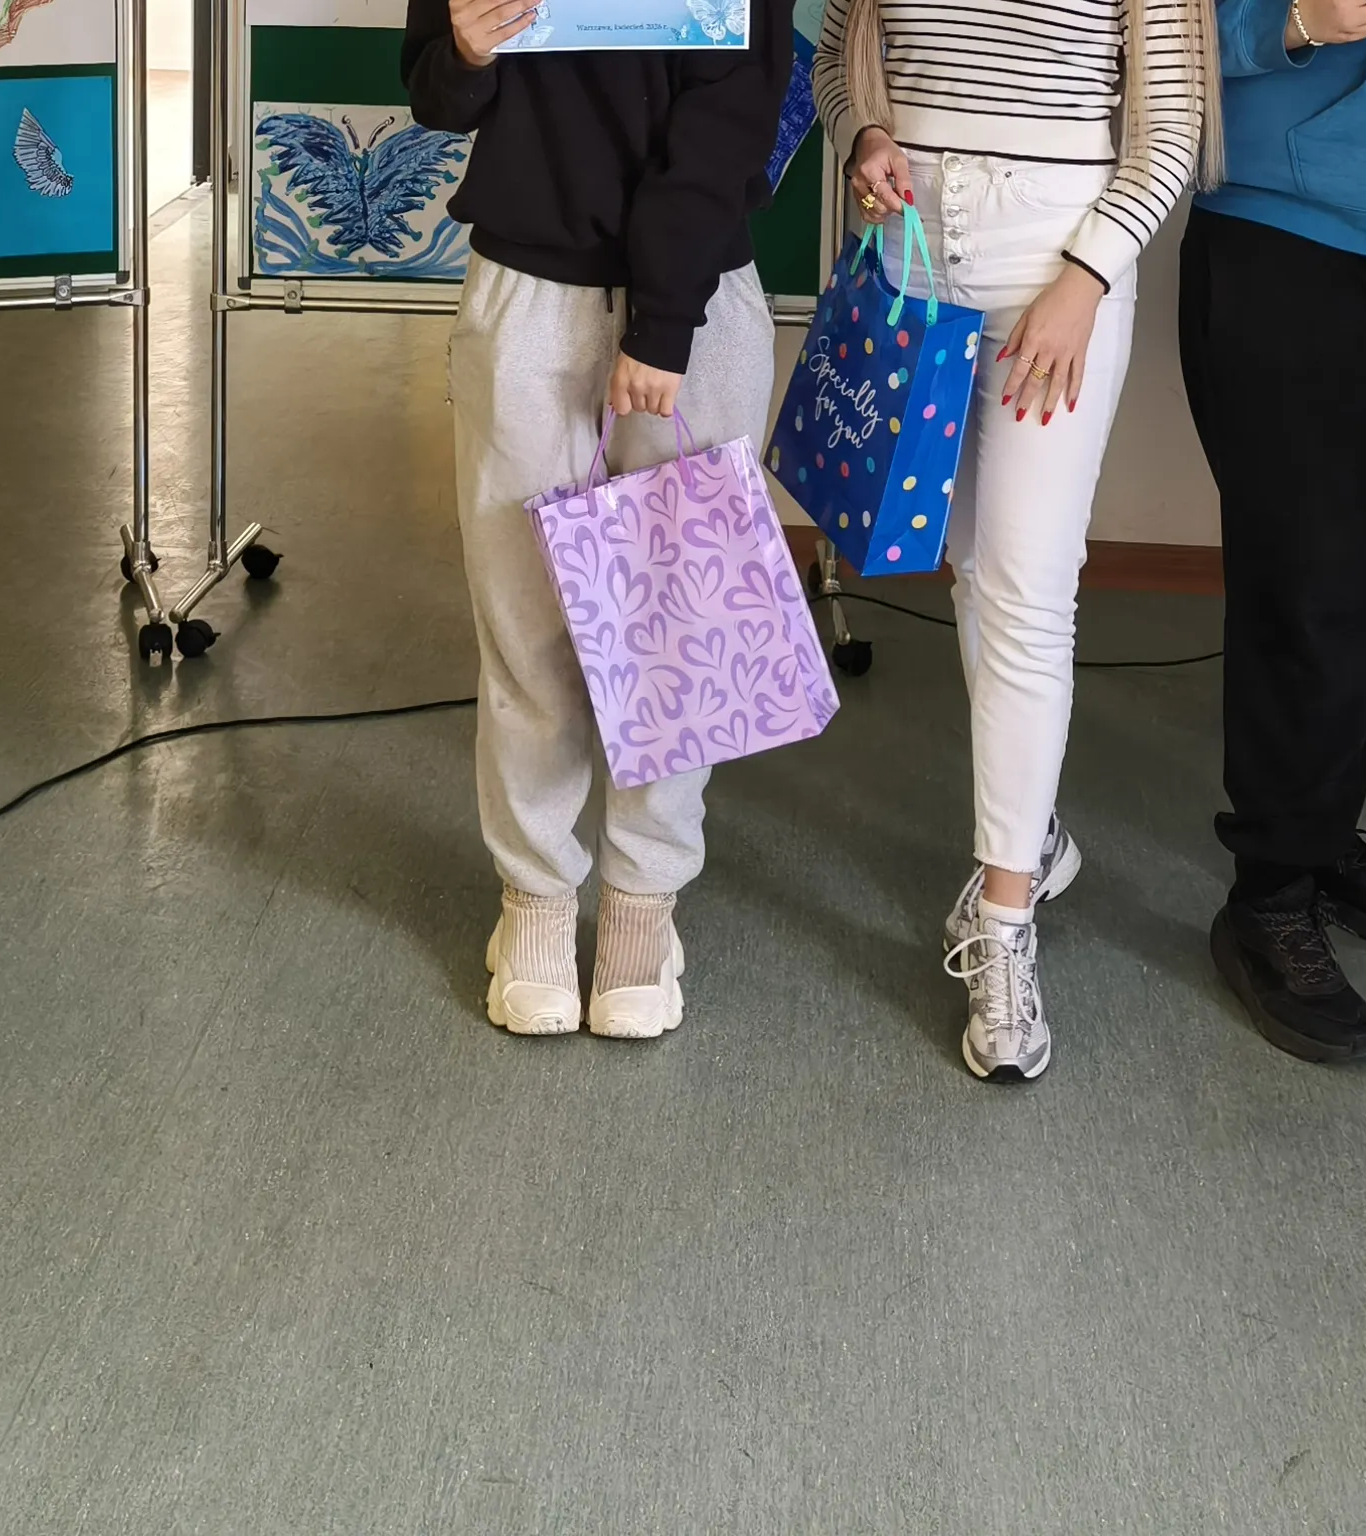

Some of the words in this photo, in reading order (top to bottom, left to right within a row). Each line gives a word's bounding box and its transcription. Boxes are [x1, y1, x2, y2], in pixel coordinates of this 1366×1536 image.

[808, 335, 884, 440] Specially
[815, 381, 838, 421] for
[827, 414, 864, 449] you
